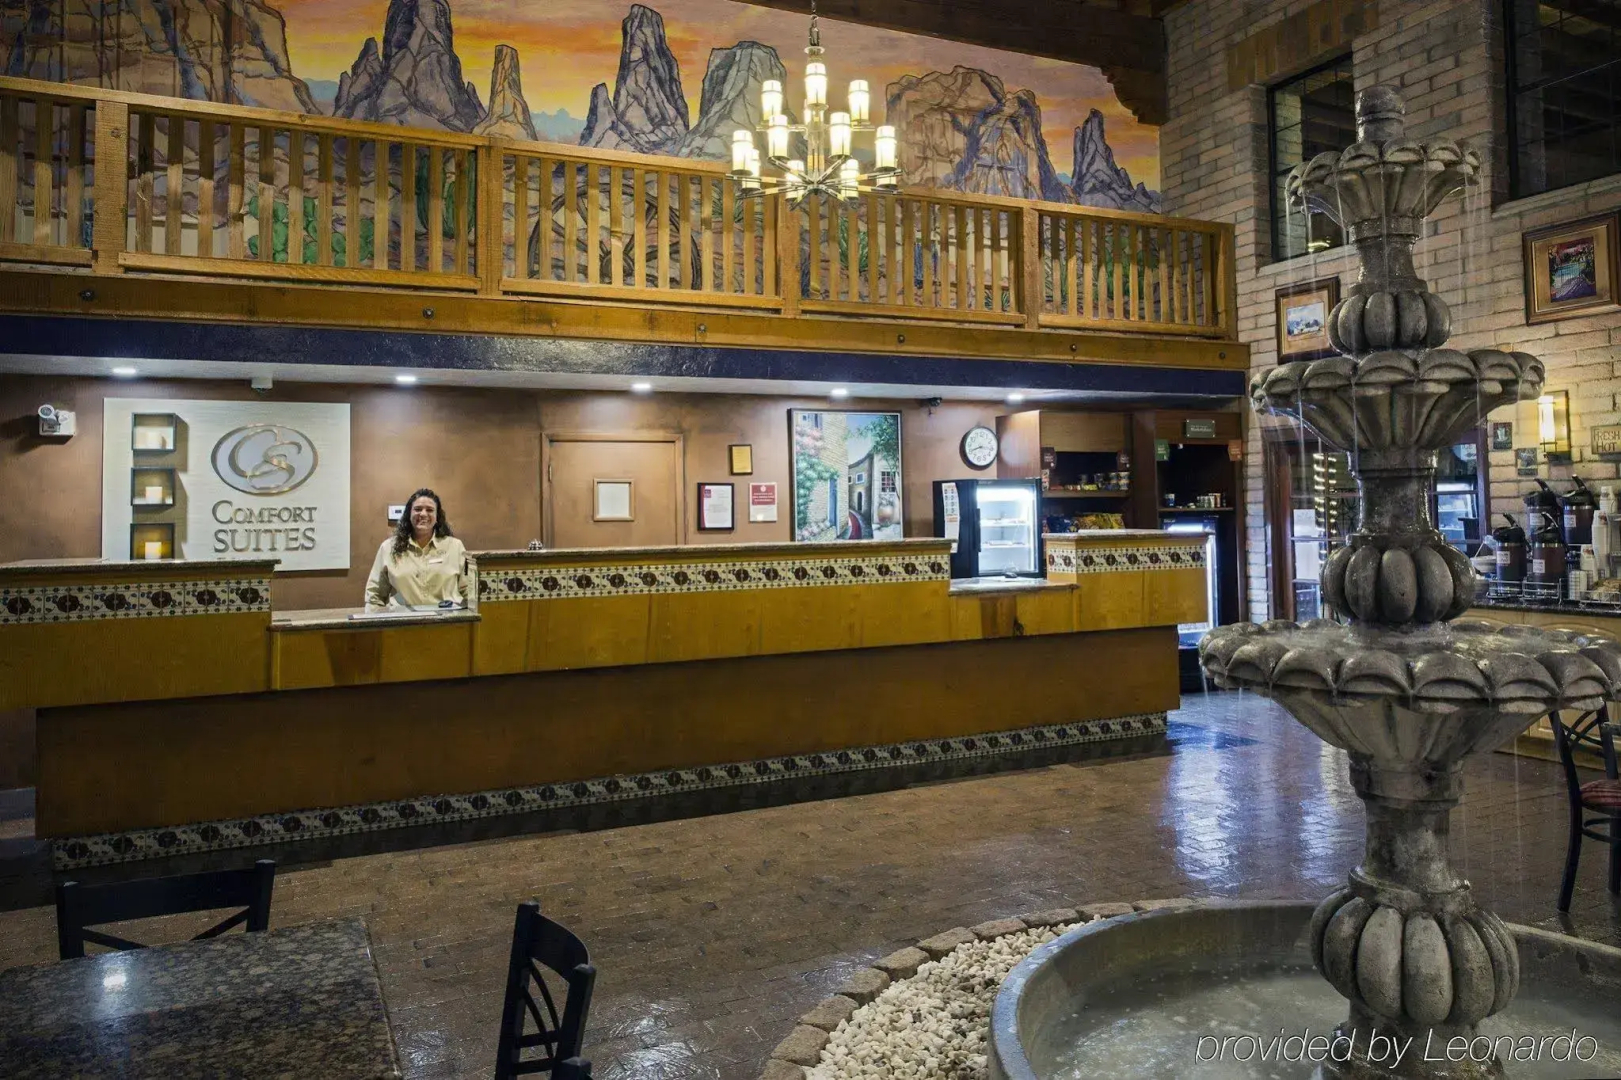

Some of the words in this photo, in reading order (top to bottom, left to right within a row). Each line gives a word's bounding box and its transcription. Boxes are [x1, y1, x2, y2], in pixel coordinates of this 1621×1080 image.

[1593, 428, 1620, 441] FRESH
[1596, 440, 1617, 452] HOT
[211, 500, 318, 524] COMFORT
[213, 527, 316, 553] SUITES
